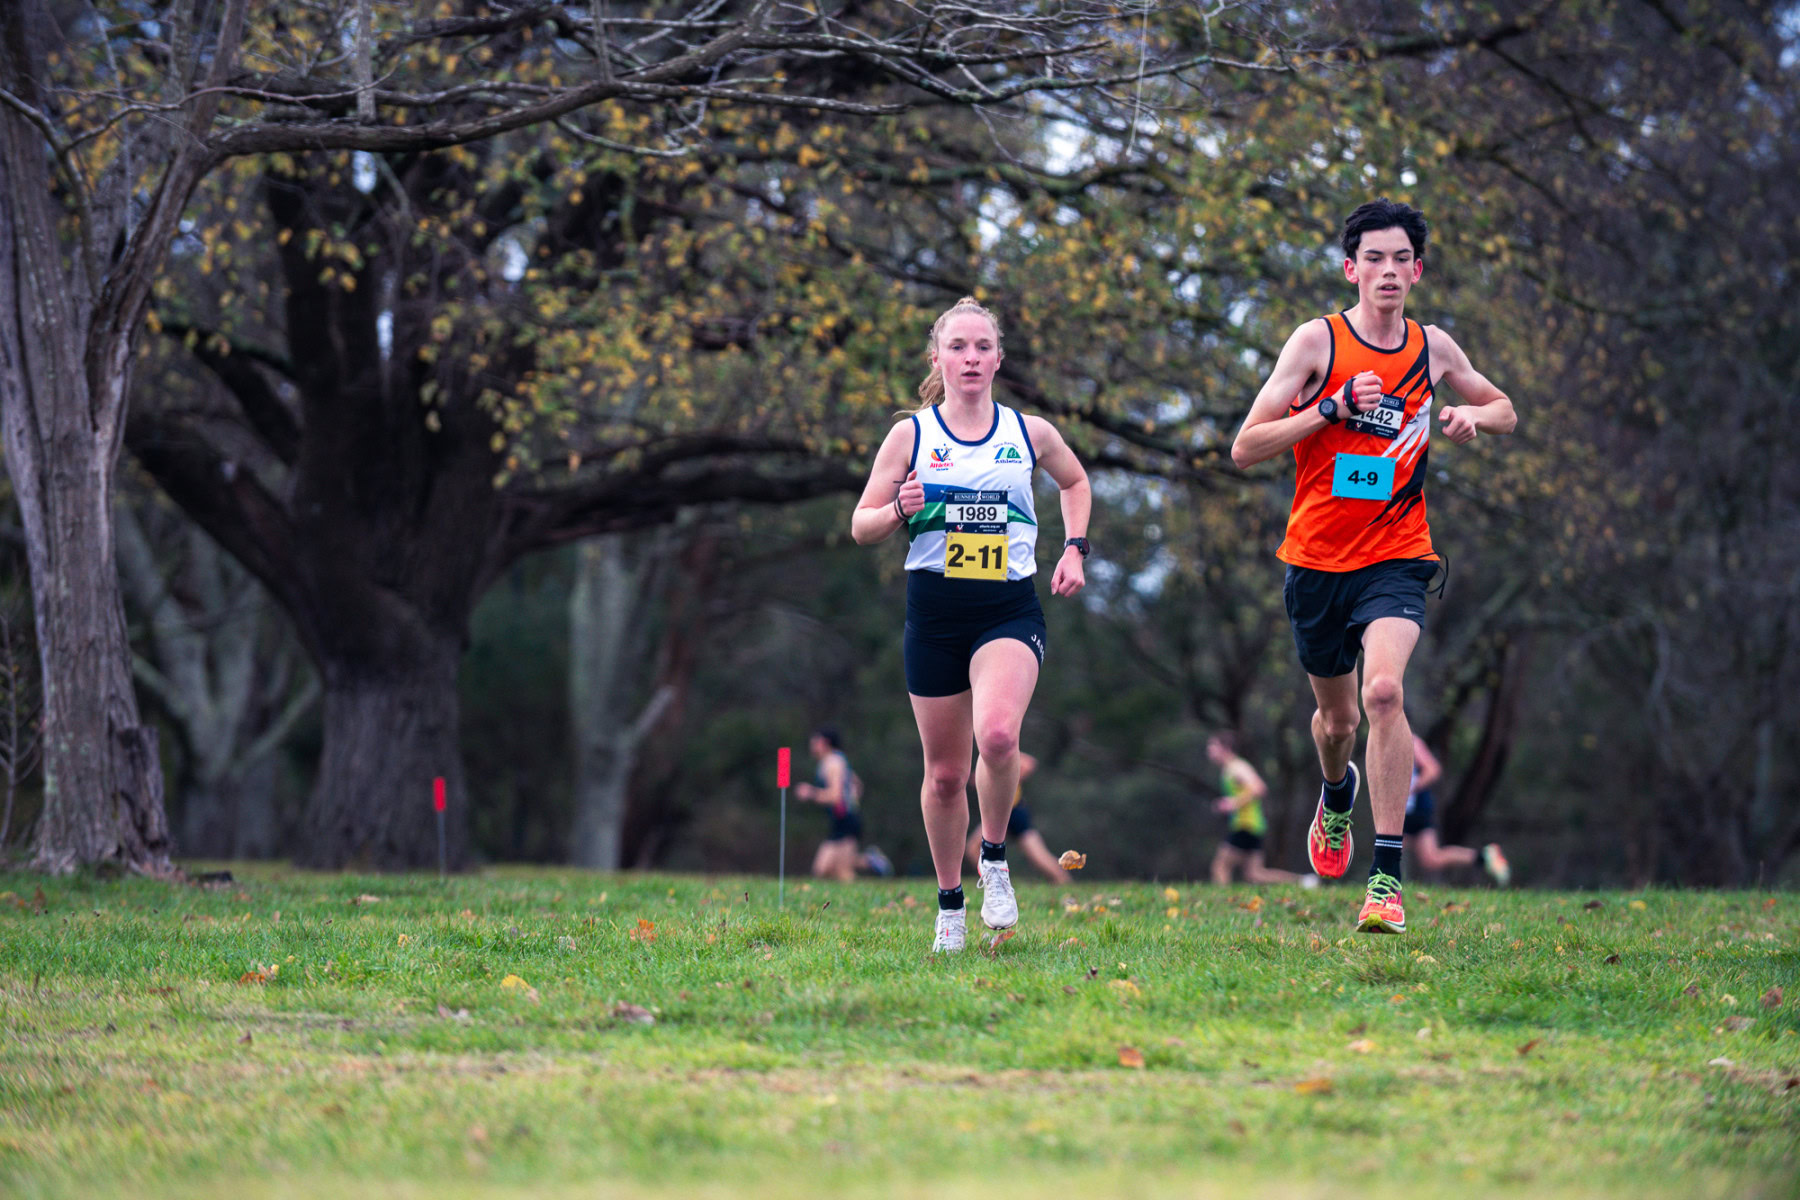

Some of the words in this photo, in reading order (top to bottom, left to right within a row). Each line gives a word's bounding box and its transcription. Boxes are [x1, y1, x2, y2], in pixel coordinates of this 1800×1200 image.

[1347, 469, 1379, 486] 4-9
[957, 506, 997, 522] 1989
[948, 543, 1003, 570] 2-11
